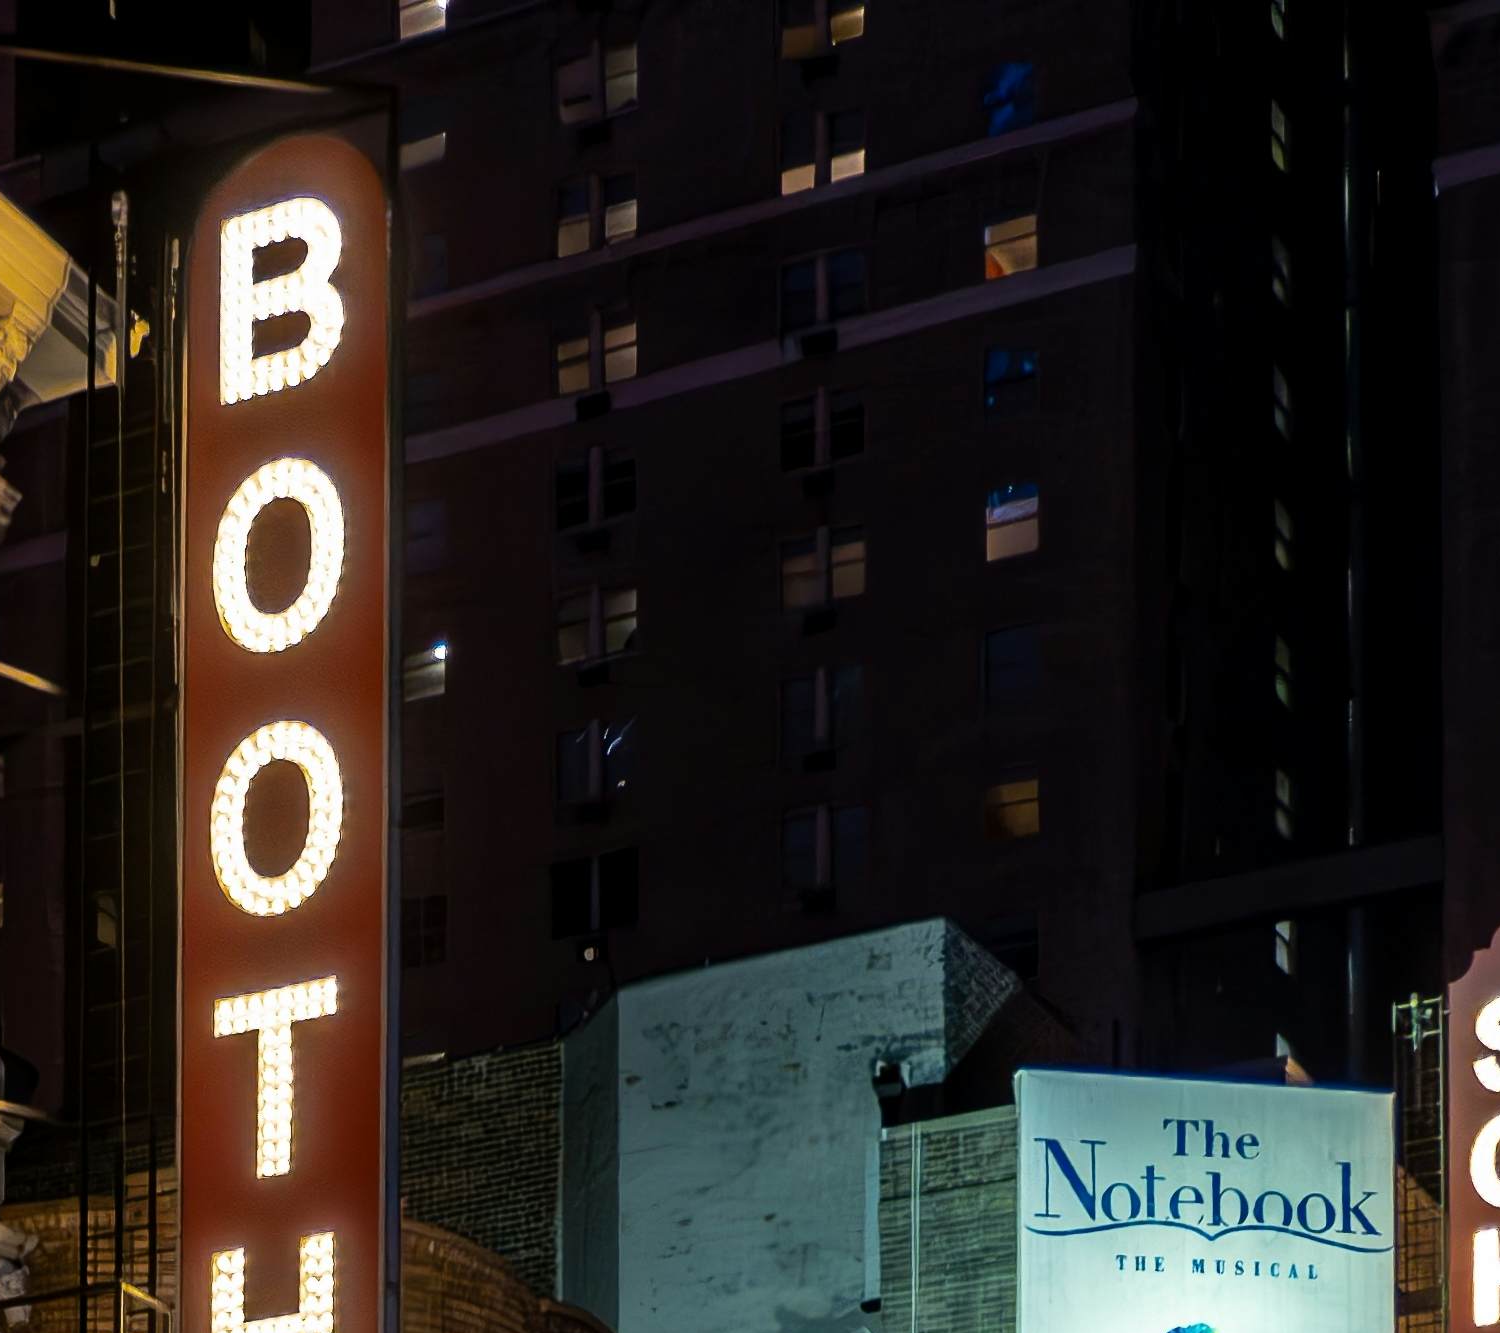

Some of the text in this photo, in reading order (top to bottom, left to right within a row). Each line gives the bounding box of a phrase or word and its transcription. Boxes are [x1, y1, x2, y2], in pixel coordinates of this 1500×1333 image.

[1162, 1116, 1261, 1161] The
[1032, 1136, 1383, 1238] Notebook
[1115, 1254, 1320, 1281] THE MUSICAL
